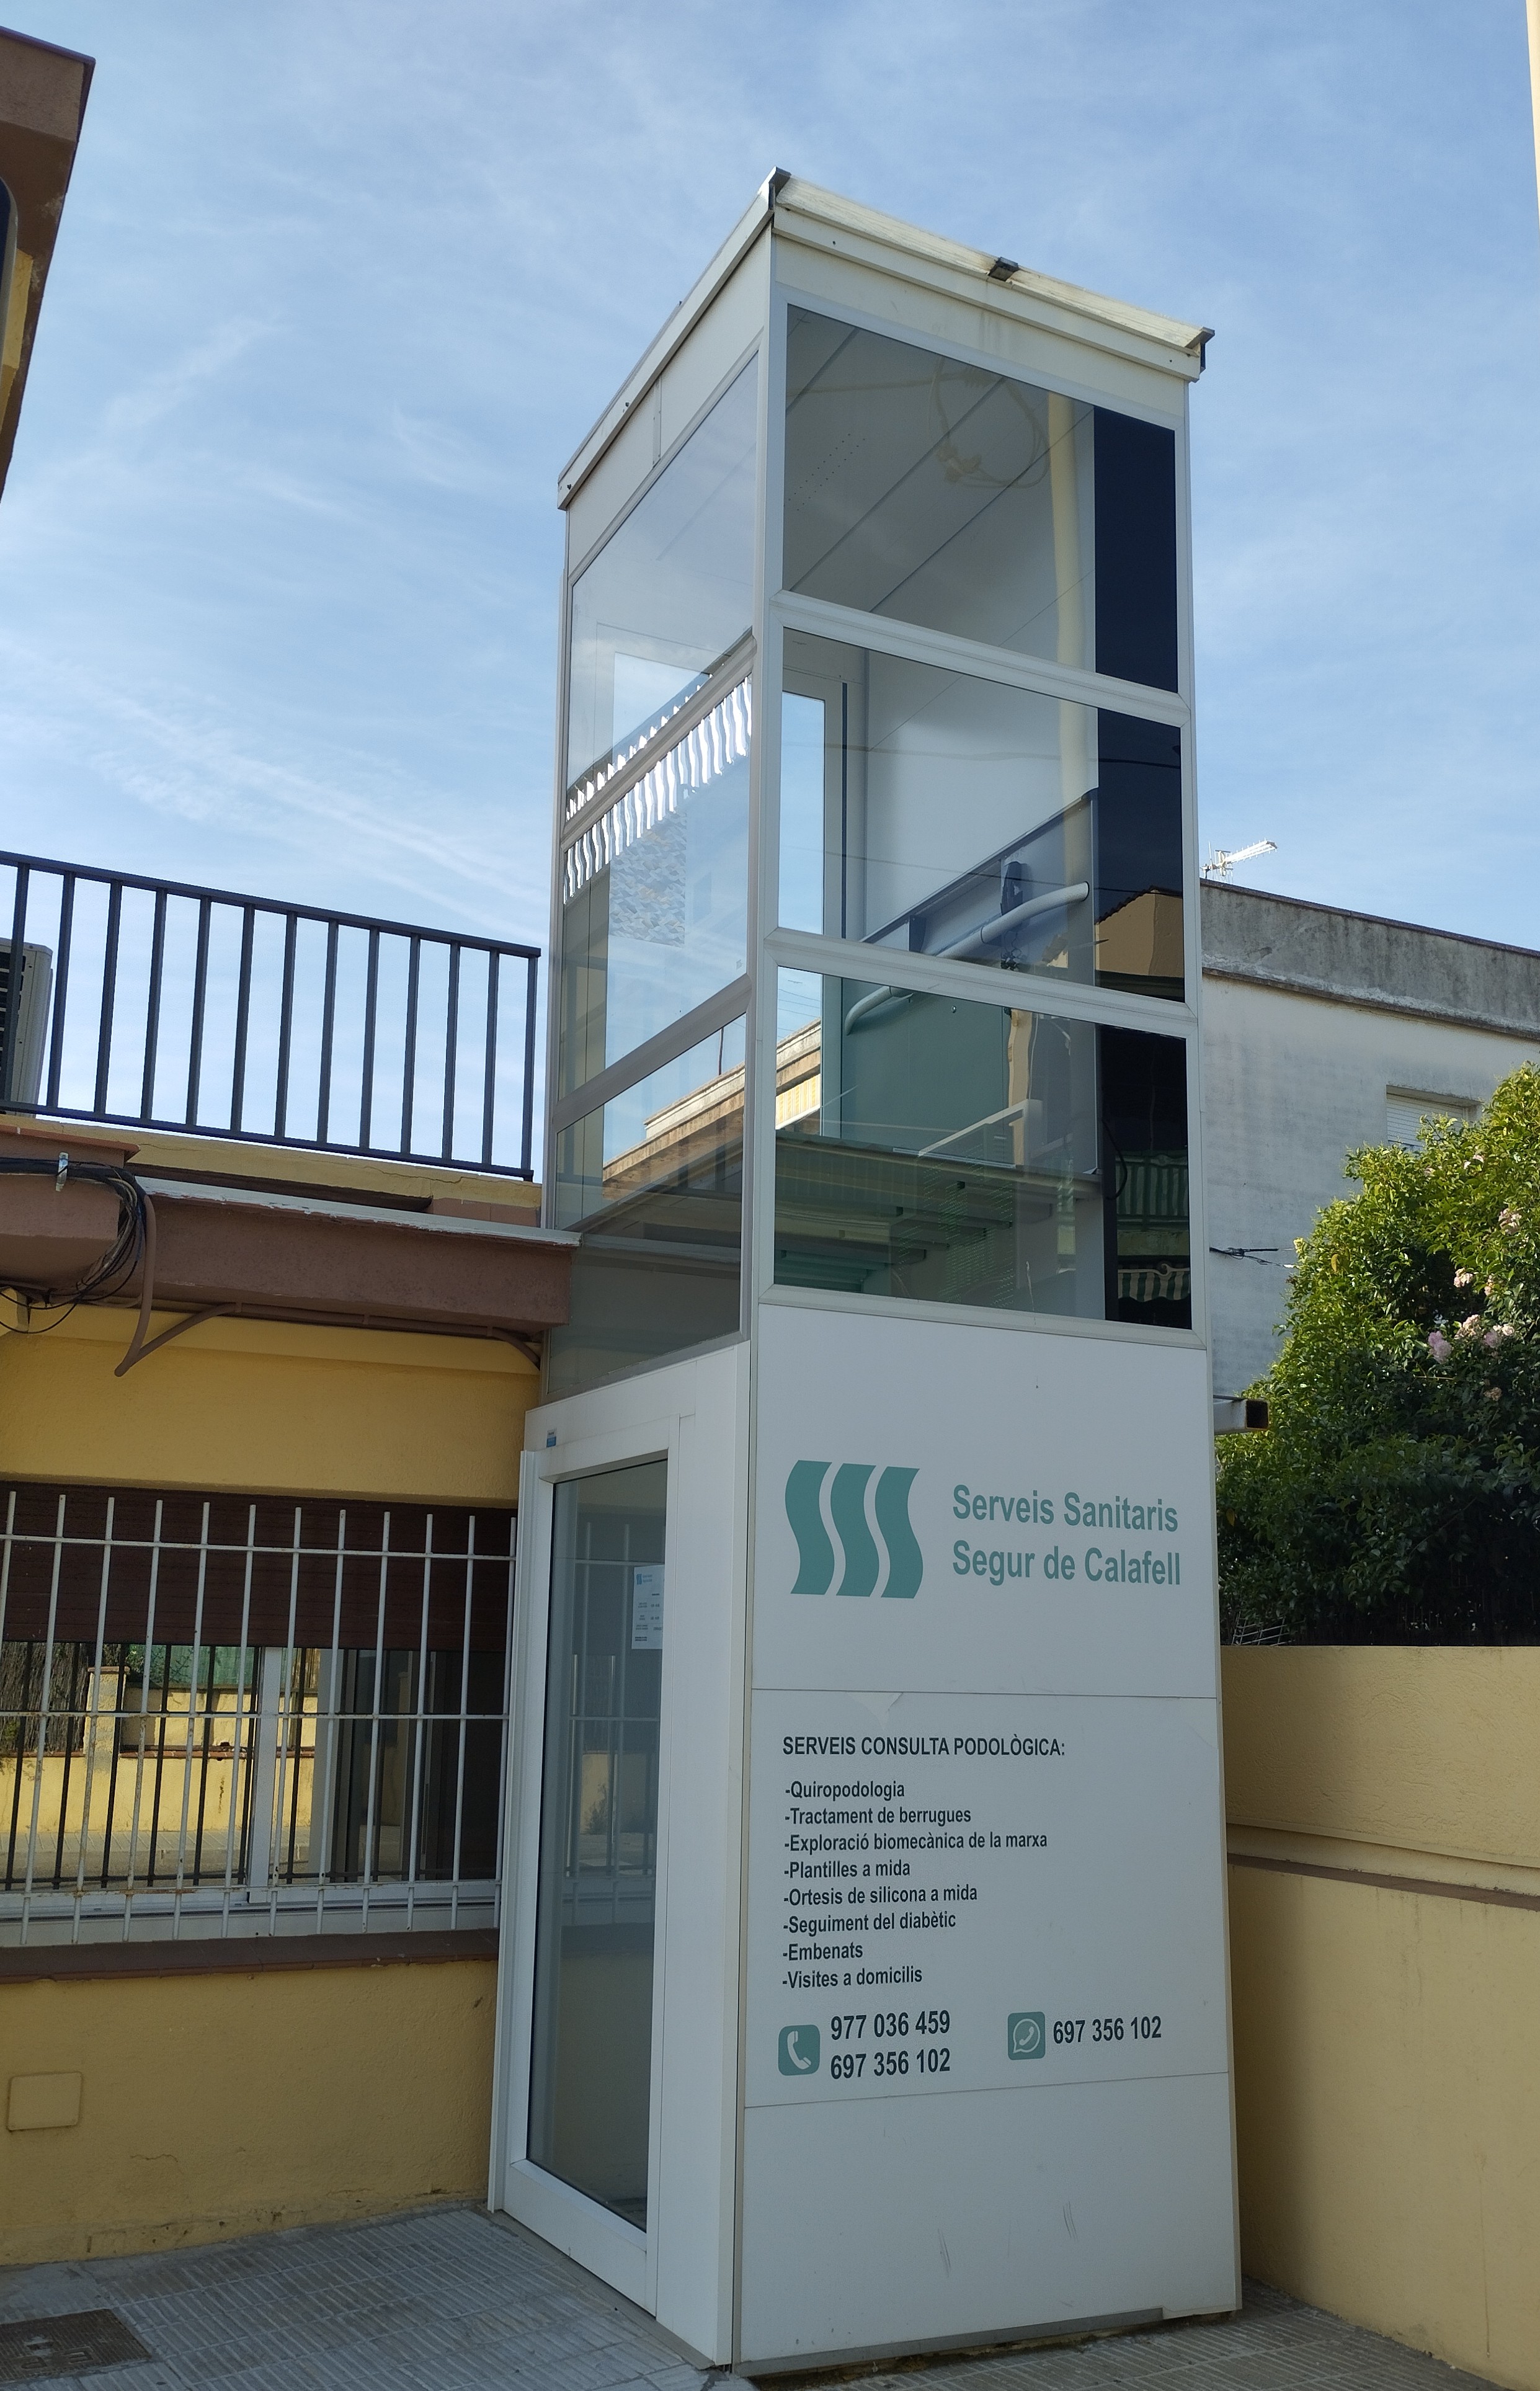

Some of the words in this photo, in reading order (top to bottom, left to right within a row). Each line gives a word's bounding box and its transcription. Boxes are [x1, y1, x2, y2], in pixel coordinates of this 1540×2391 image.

[953, 1484, 1054, 1525] Serveis
[1063, 1492, 1178, 1532] Sanitaris
[952, 1539, 1036, 1586] Segur
[1043, 1545, 1075, 1580] de
[1084, 1547, 1180, 1585] Calafell
[783, 1736, 856, 1755] SERVEIS
[861, 1737, 950, 1755] CONSULTA
[954, 1734, 1065, 1756] PODOLÒGICA:
[785, 1780, 905, 1802] -Quiropodologia
[785, 1807, 873, 1825] -Tractament
[877, 1806, 895, 1823] de
[899, 1806, 971, 1827] berrugues
[784, 1833, 870, 1856] -Exploració
[874, 1832, 964, 1850] biomecànica
[968, 1832, 986, 1848] de
[990, 1831, 1001, 1848] la
[1006, 1835, 1048, 1848] marxa
[784, 1860, 858, 1879] -Plantilles
[862, 1864, 871, 1877] a
[876, 1859, 910, 1877] mida
[783, 1887, 843, 1906] -Ortesis
[848, 1887, 865, 1904] de
[870, 1886, 926, 1903] silicona
[930, 1889, 939, 1902] a
[943, 1884, 977, 1901] mida
[783, 1914, 869, 1937] -Seguiment
[873, 1912, 895, 1930] del
[899, 1910, 956, 1929] diabètic
[783, 1941, 863, 1961] -Embenats
[782, 1970, 839, 1988] -Visites
[843, 1972, 852, 1986] a
[856, 1965, 922, 1985] domicilis
[830, 2015, 867, 2041] 977
[874, 2012, 909, 2037] 036
[915, 2010, 950, 2034] 459
[1053, 2019, 1085, 2044] 697
[1092, 2018, 1124, 2042] 356
[1131, 2016, 1162, 2039] 102
[830, 2053, 866, 2080] 697
[873, 2050, 909, 2077] 356
[916, 2047, 950, 2073] 102
